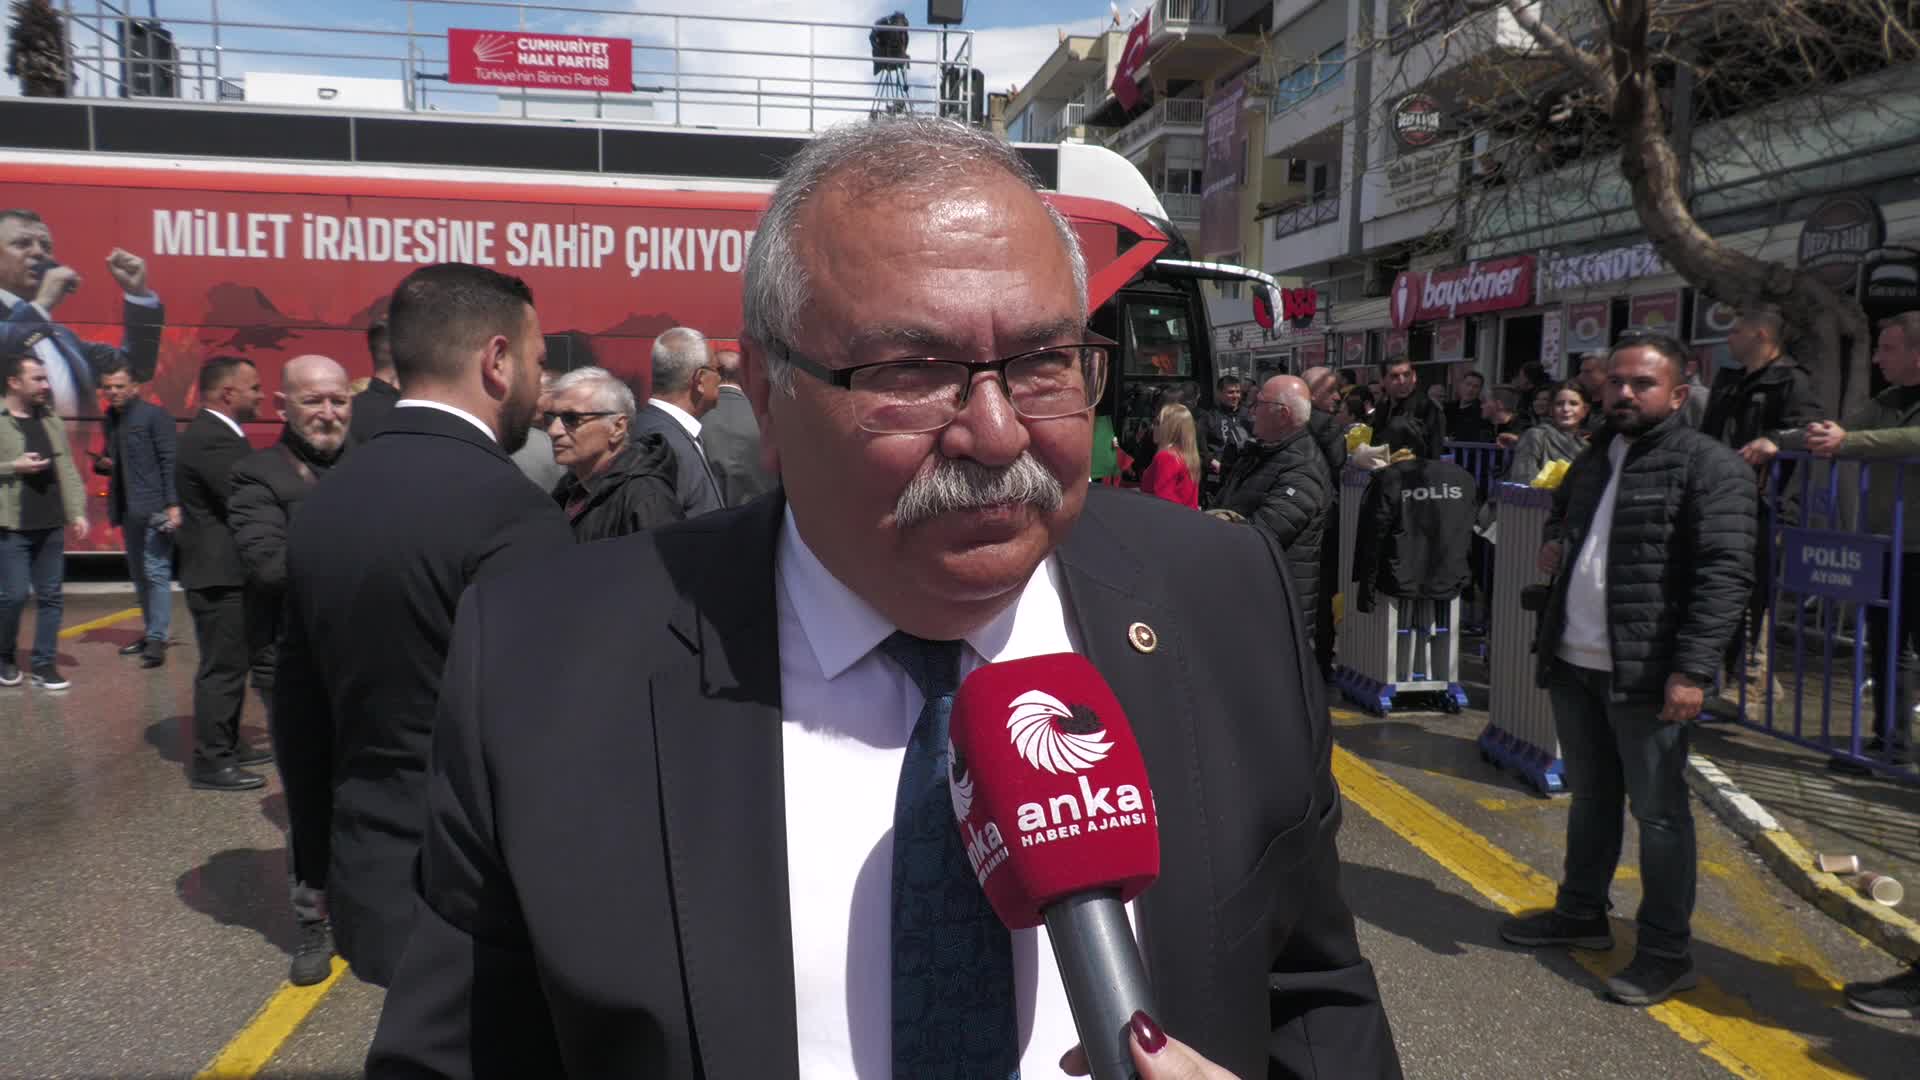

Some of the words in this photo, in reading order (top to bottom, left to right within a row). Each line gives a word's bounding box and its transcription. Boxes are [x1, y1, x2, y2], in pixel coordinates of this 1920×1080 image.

[517, 37, 609, 55] CUMHURİYET
[518, 52, 553, 66] HALK
[557, 54, 609, 70] PARTİSİ
[474, 67, 535, 83] Türkiye'nin
[537, 71, 572, 86] Birinci
[574, 73, 609, 87] Partisi
[1423, 260, 1522, 318] baydöner
[1401, 483, 1463, 503] POLİS
[1802, 544, 1862, 570] POLİS
[1017, 776, 1144, 832] anka
[1021, 824, 1081, 847] HABER
[1087, 812, 1147, 833] AJANSI
